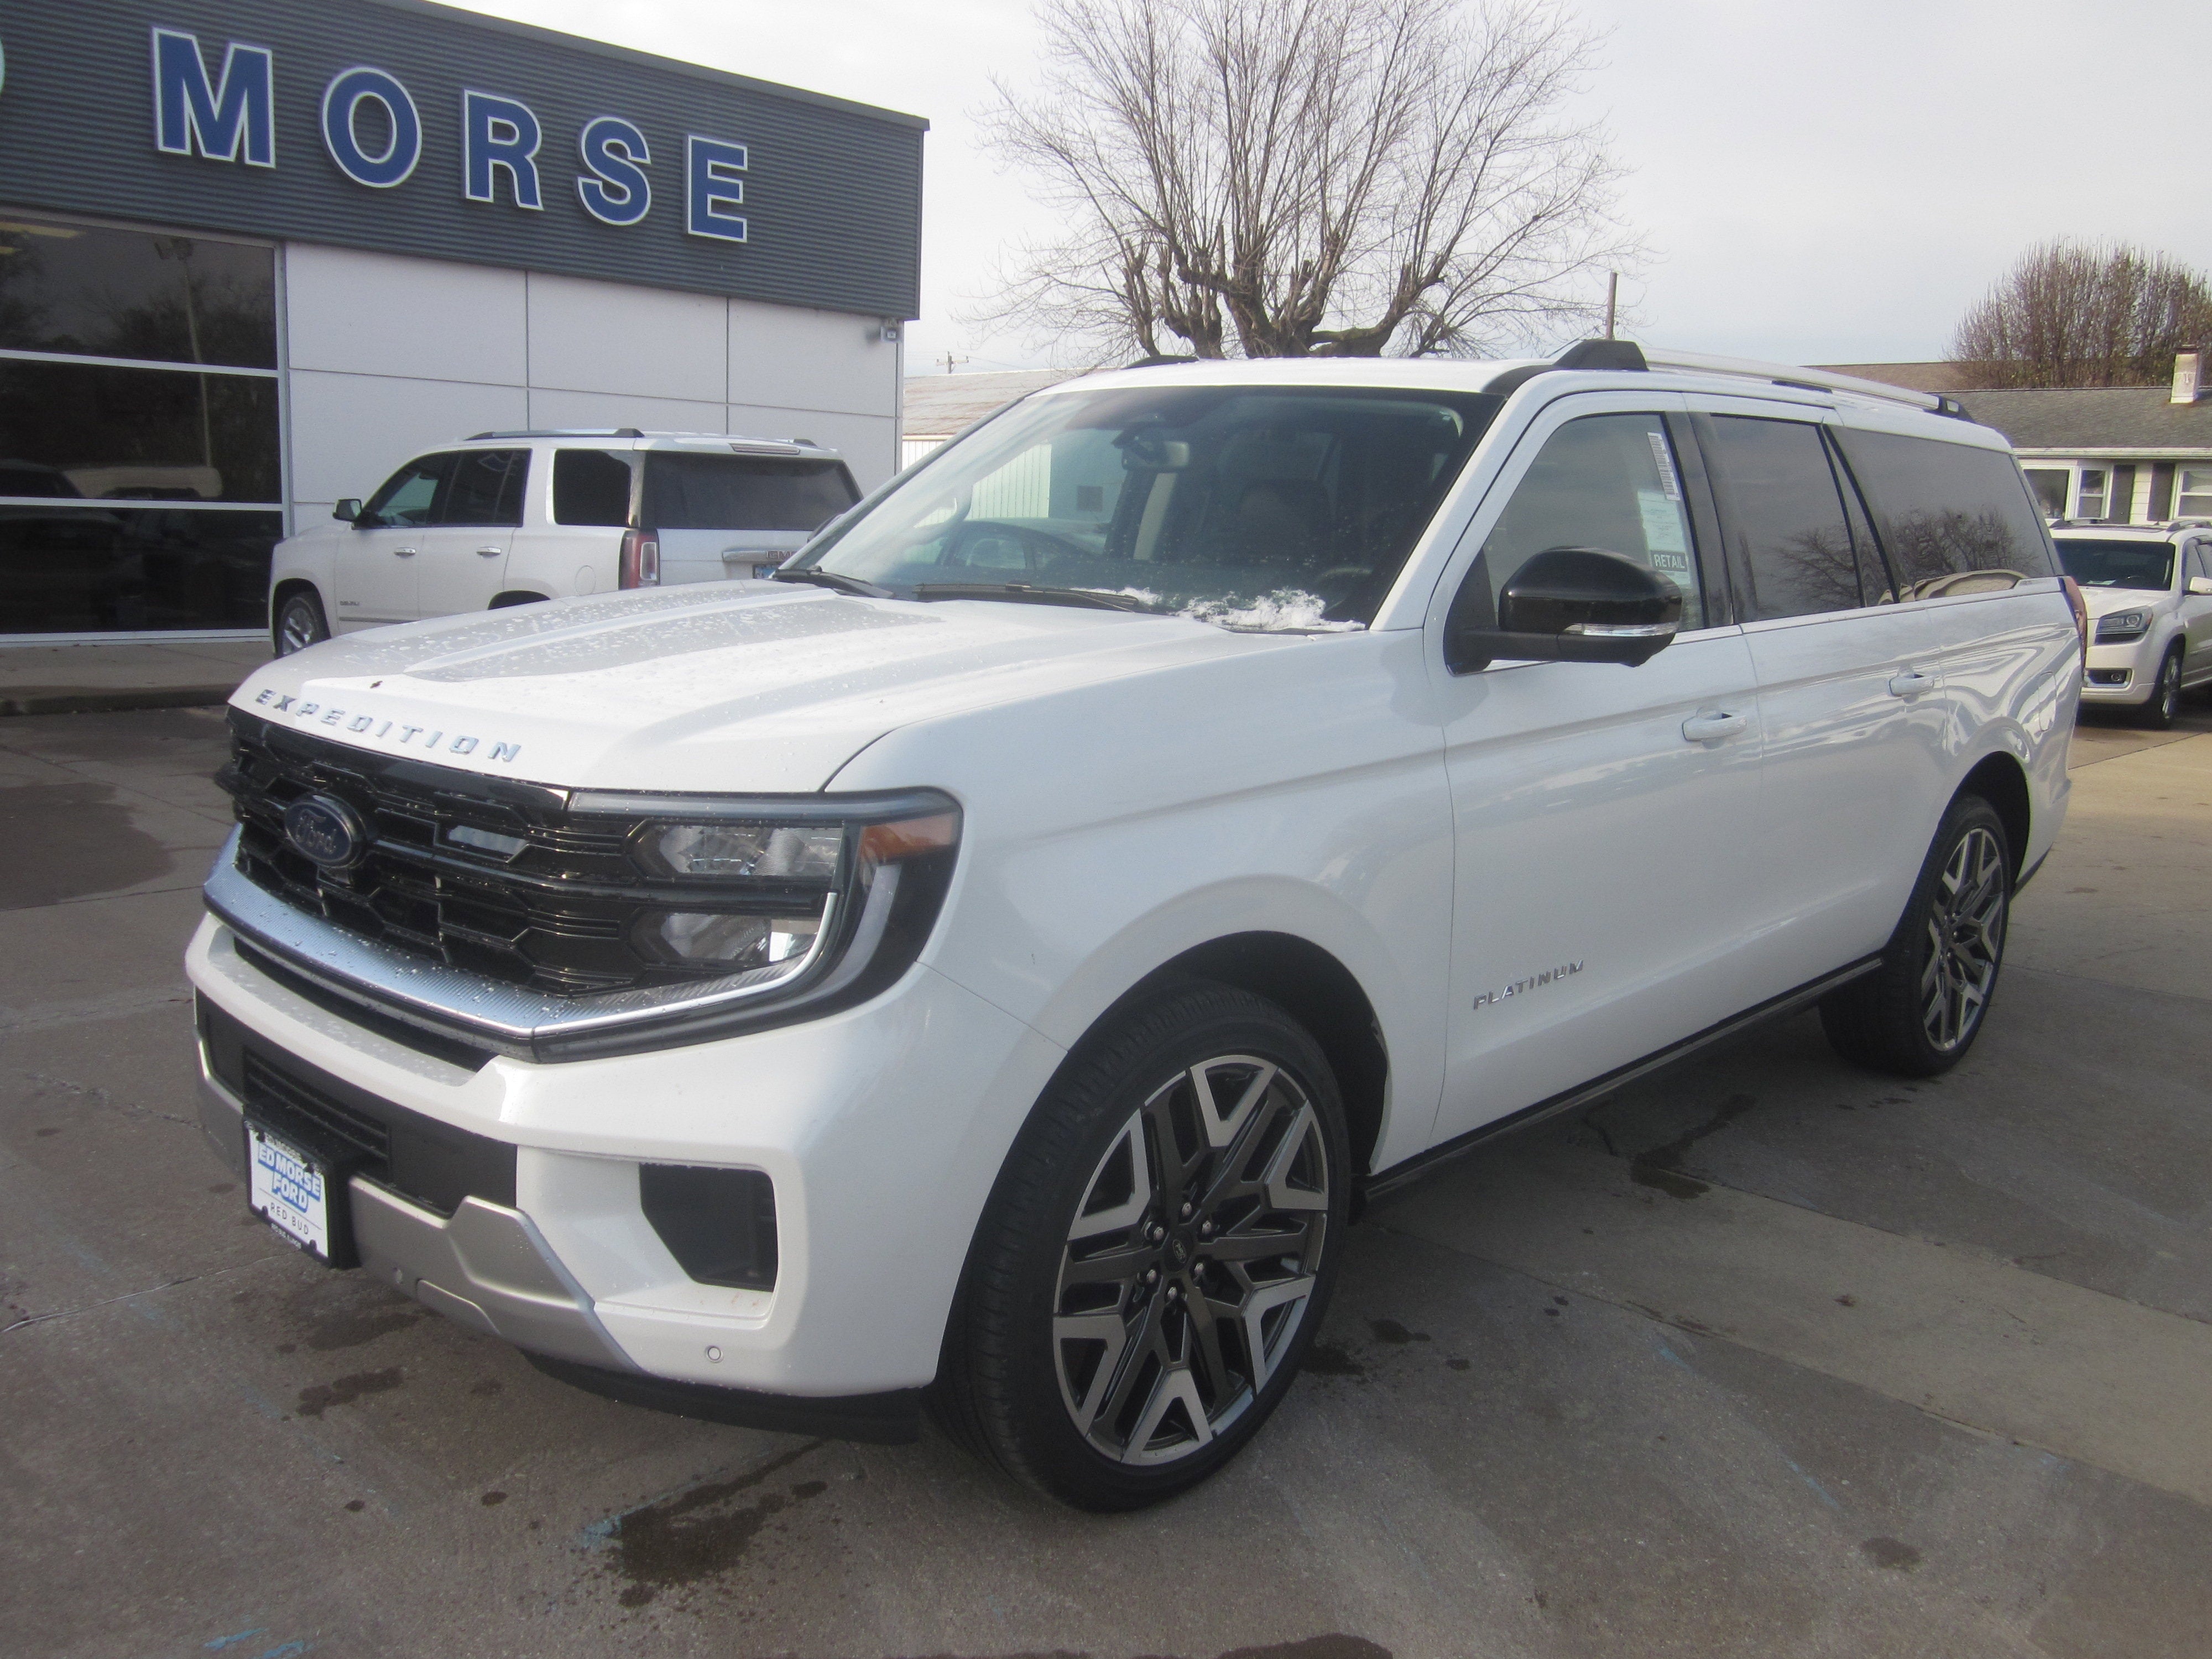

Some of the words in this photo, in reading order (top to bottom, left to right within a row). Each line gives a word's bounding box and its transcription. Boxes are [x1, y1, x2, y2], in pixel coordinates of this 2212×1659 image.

[152, 27, 748, 243] MORSE
[766, 549, 797, 560] GM
[1654, 554, 1686, 569] RETAIL
[255, 689, 522, 762] EXPEDITION
[295, 808, 337, 854] Ford
[1473, 959, 1584, 1010] PLATINUM
[258, 1142, 275, 1168] ED
[275, 1152, 321, 1200] MORSE
[272, 1172, 309, 1213] FORD
[270, 1202, 287, 1219] RED
[291, 1215, 310, 1235] BUD
